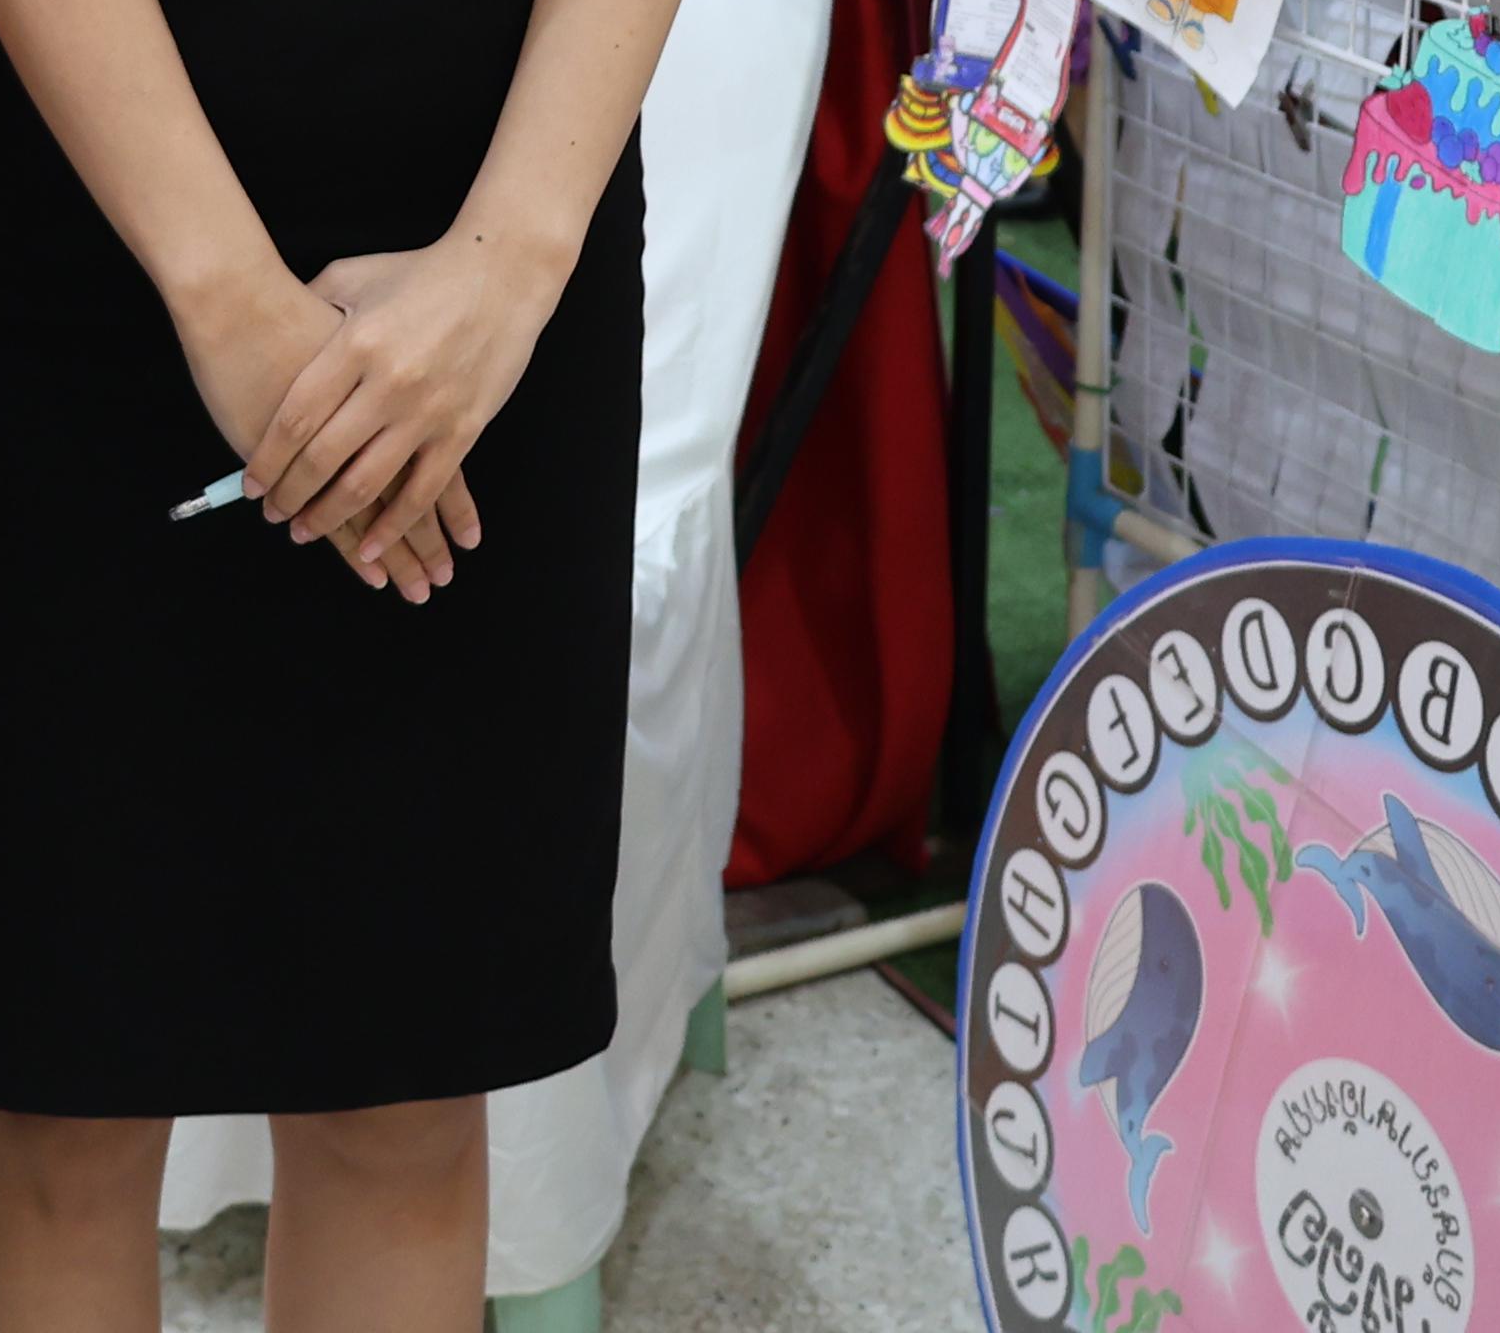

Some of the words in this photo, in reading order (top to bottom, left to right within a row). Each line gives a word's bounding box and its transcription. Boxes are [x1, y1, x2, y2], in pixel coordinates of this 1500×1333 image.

[1157, 644, 1202, 725] E
[1242, 610, 1279, 684] D
[1327, 624, 1364, 702] C
[1100, 691, 1144, 772] F
[1420, 657, 1460, 745] B
[1047, 768, 1092, 840] G
[1004, 863, 1060, 940] H
[992, 997, 1042, 1055] I
[991, 1108, 1040, 1168] J
[1273, 1079, 1463, 1313] อักษรภาษาอังกฤษ
[1009, 1240, 1059, 1289] K
